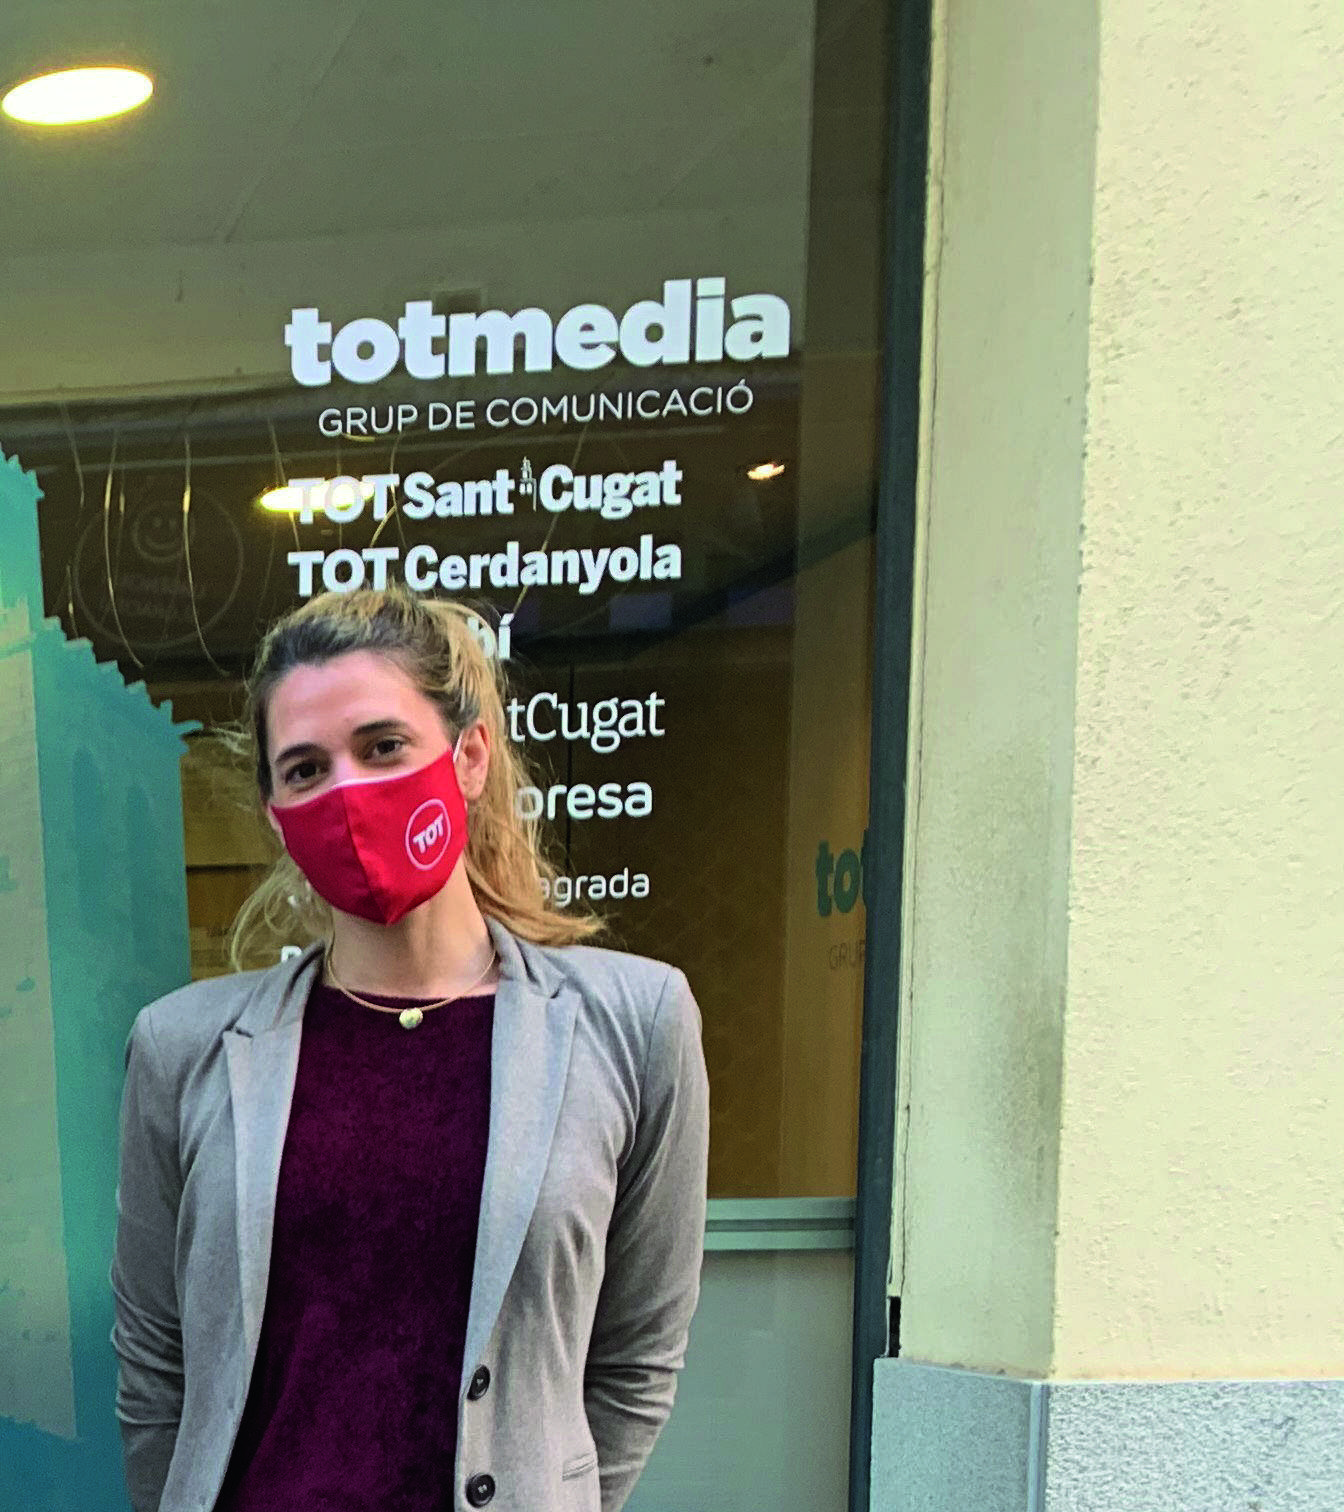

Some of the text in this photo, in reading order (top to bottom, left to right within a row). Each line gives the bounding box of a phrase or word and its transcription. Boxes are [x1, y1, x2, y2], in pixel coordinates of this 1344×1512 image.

[284, 276, 791, 387] totmedia
[318, 380, 754, 438] GRUP DE COMUNICACIÓ
[288, 459, 683, 525] TOT Sant Cugat
[287, 533, 682, 597] TOT Cerdanyola
[412, 811, 444, 854] TOT
